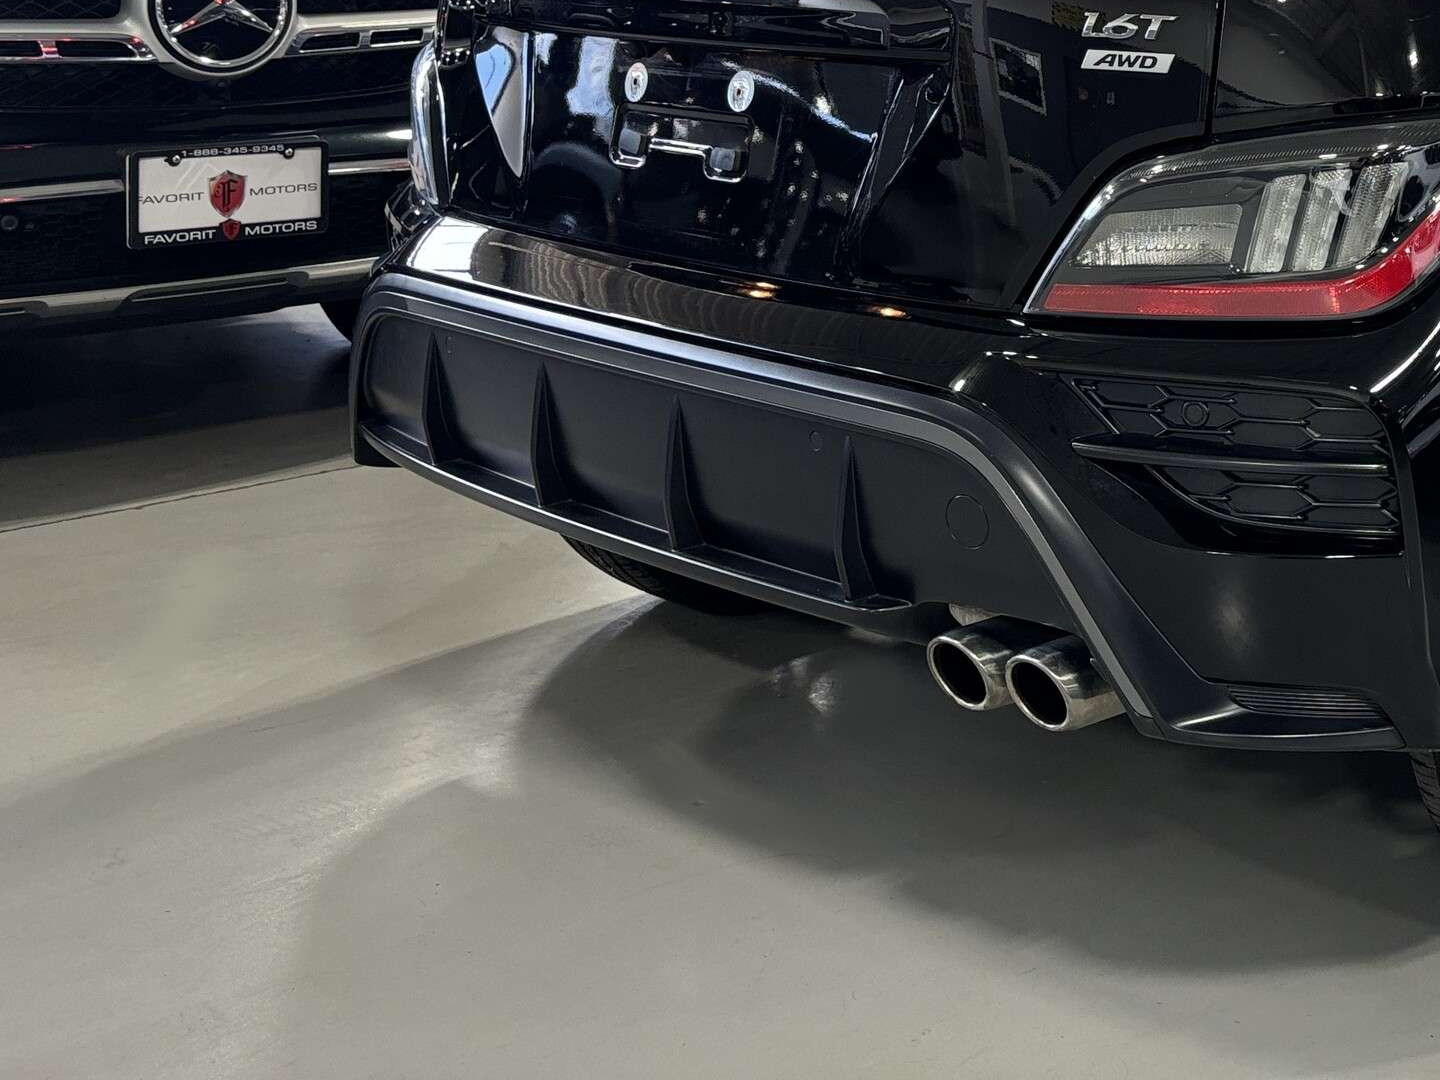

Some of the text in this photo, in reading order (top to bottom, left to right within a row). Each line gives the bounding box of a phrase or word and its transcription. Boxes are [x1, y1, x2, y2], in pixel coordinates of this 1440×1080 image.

[1081, 11, 1180, 40] 1.6T
[1092, 53, 1159, 69] AWD
[181, 144, 285, 157] 1-888-345-9345
[249, 182, 318, 196] MOTORS
[144, 229, 217, 245] FAVORIT
[244, 220, 318, 236] MOTORS
